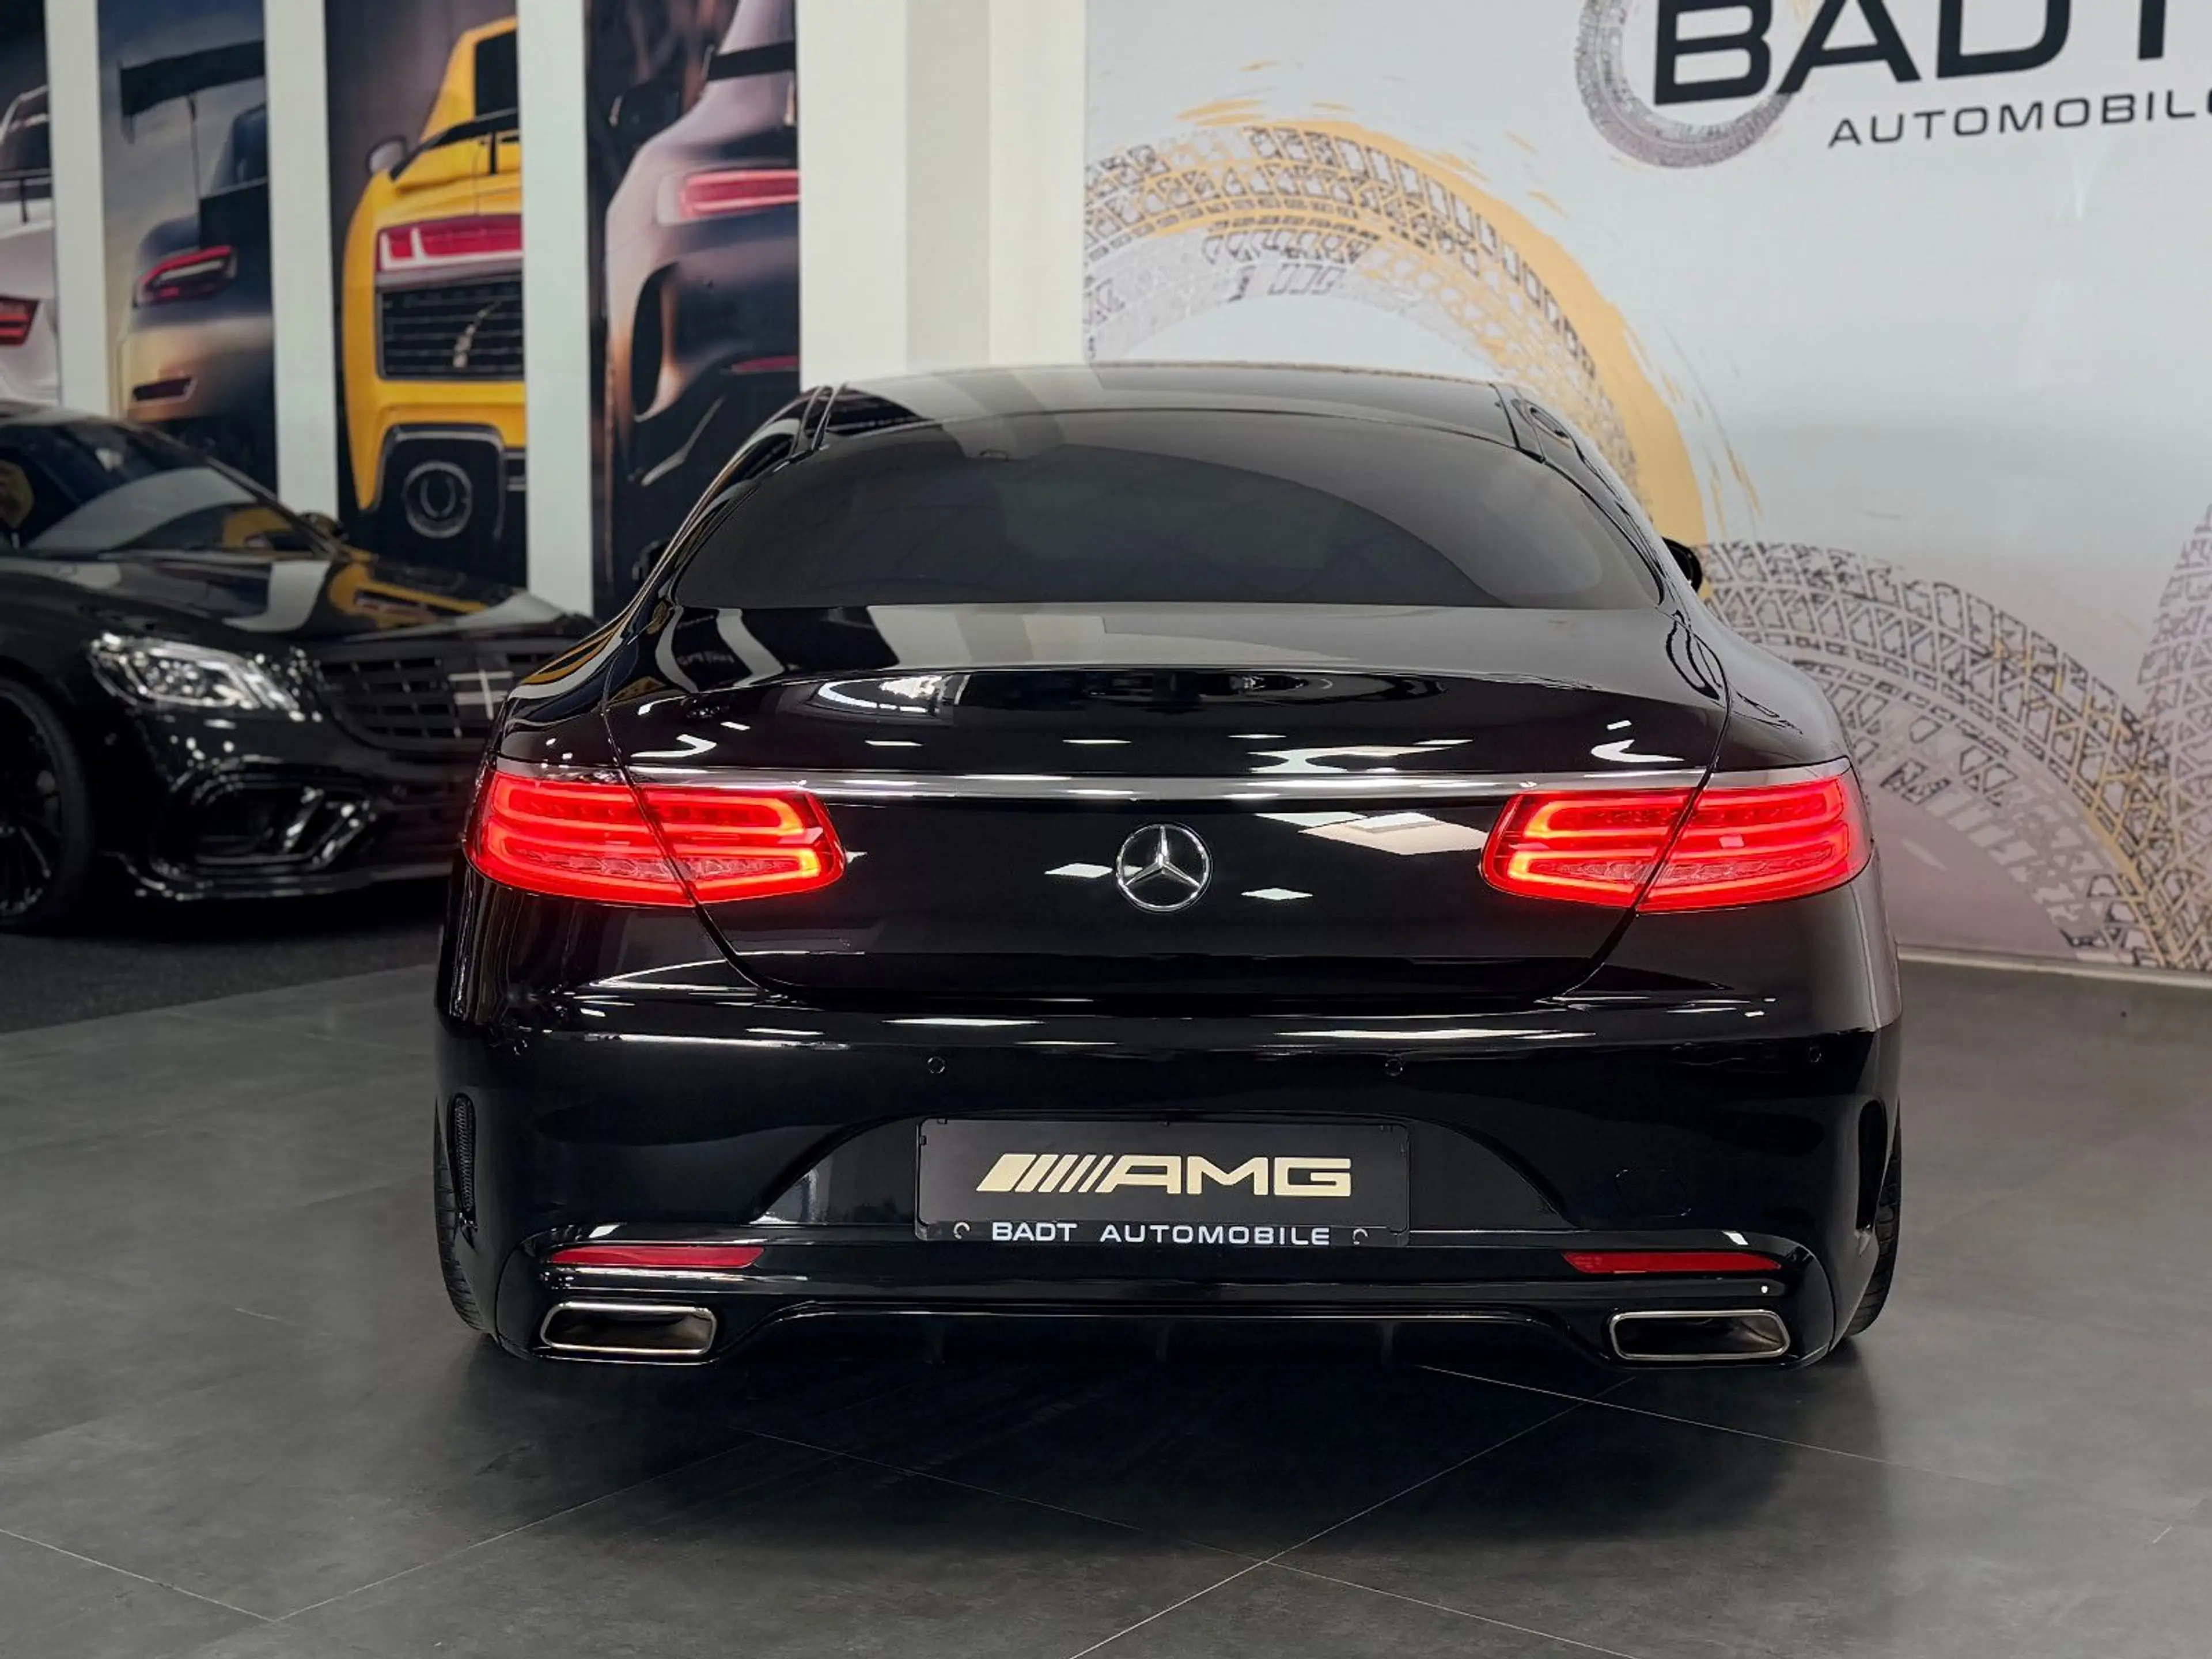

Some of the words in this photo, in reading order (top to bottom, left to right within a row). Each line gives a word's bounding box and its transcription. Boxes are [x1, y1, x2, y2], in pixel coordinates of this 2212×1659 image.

[1828, 87, 2212, 148] AUTOMOBIL
[992, 1222, 1078, 1242] BADT
[1099, 1224, 1330, 1245] AUTOMOBILE
